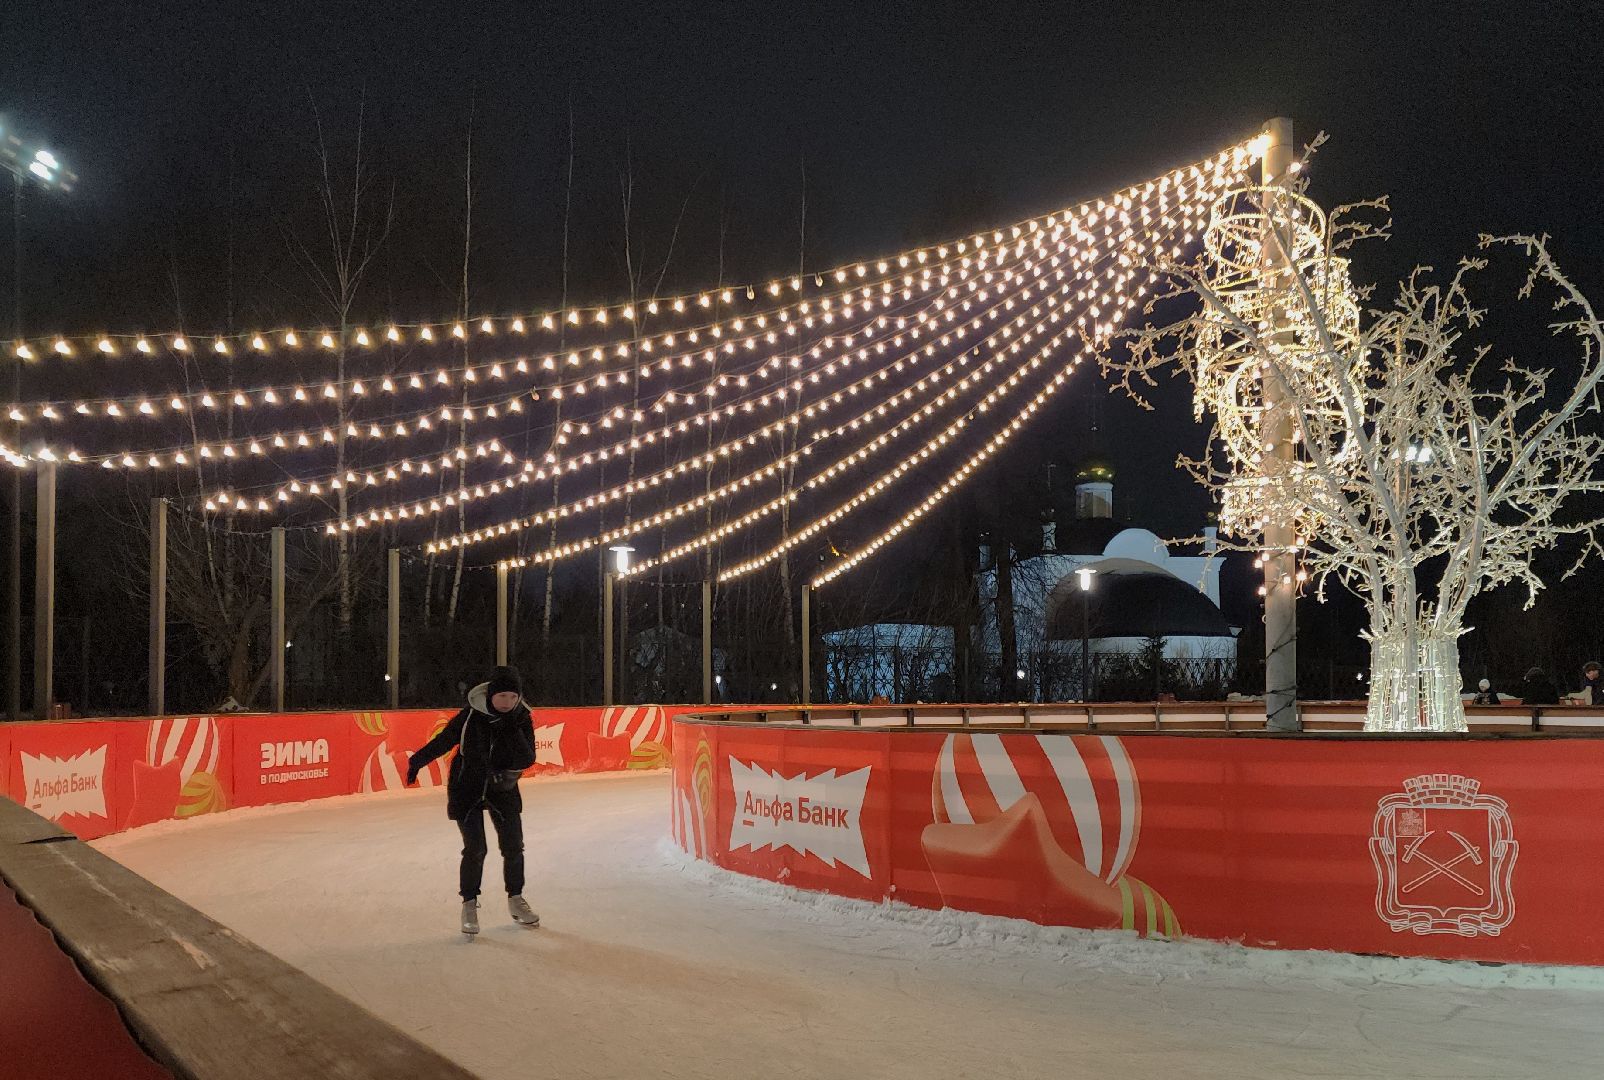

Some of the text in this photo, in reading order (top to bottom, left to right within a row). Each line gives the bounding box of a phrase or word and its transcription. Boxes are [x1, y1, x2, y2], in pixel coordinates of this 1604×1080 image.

[260, 738, 329, 769] ЗИМА
[33, 772, 98, 801] Альфа Банк
[743, 790, 850, 830] Альфа Банк
